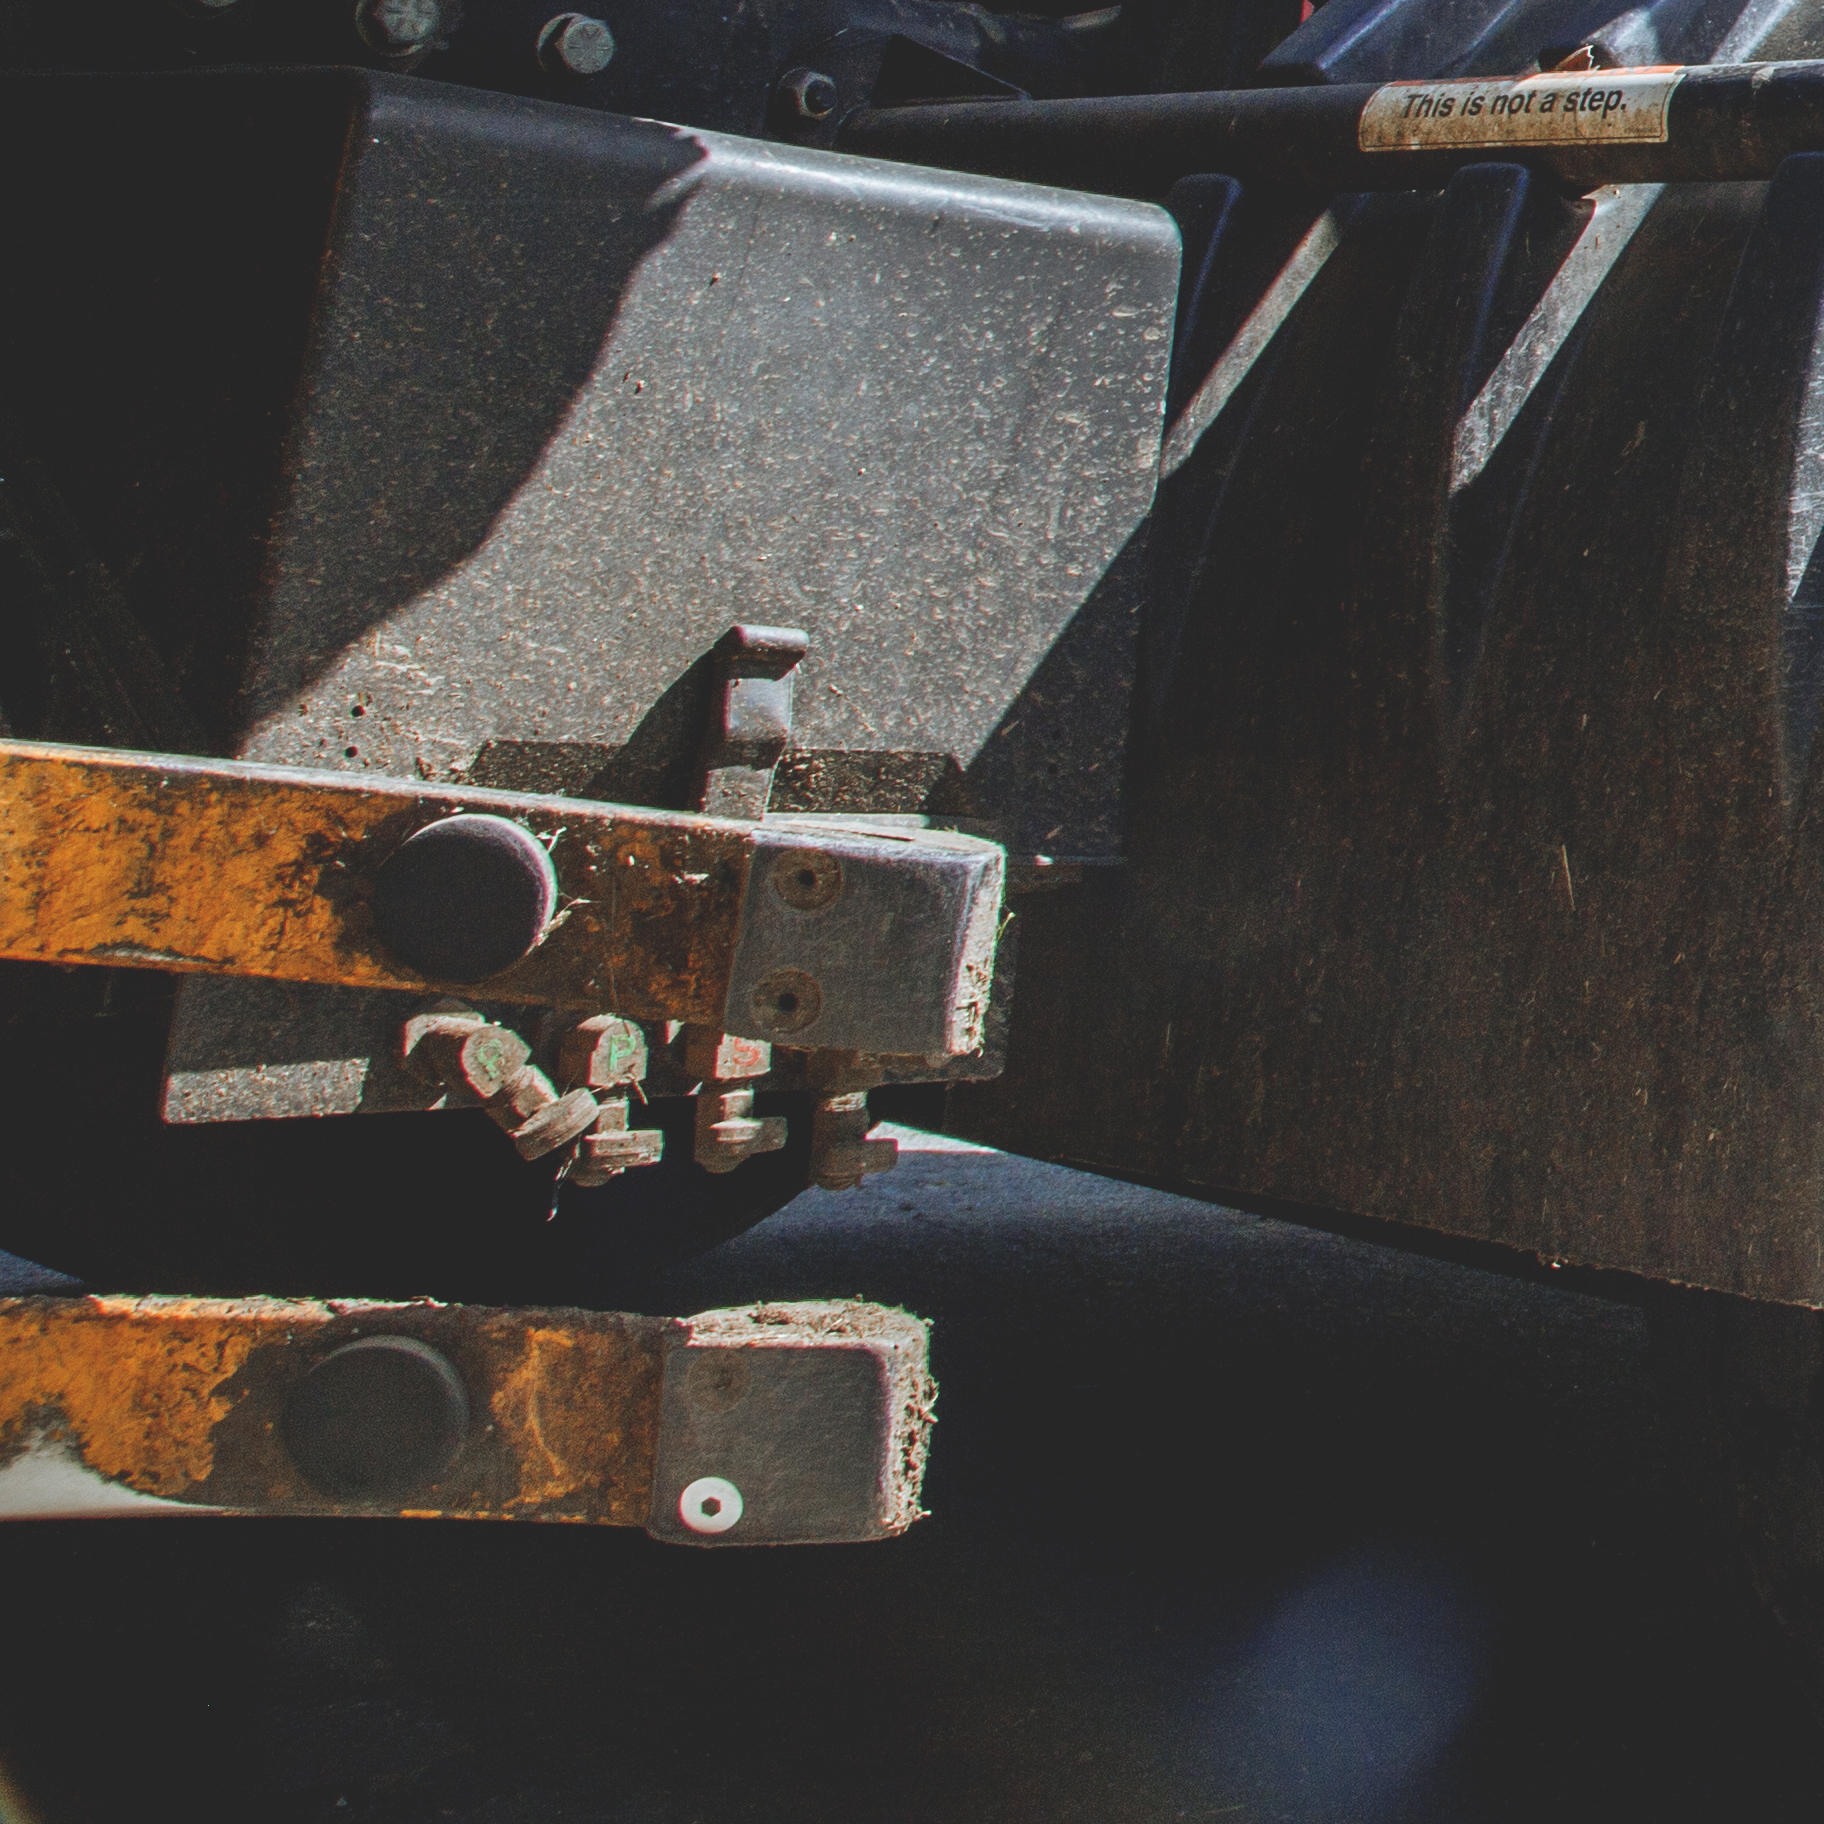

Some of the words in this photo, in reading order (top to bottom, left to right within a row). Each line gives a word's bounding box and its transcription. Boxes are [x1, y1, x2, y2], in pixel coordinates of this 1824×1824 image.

[1403, 91, 1456, 119] This
[1460, 90, 1486, 117] is
[1490, 89, 1537, 115] not
[1539, 92, 1558, 114] a
[1563, 87, 1627, 119] step.
[609, 1034, 637, 1071] P
